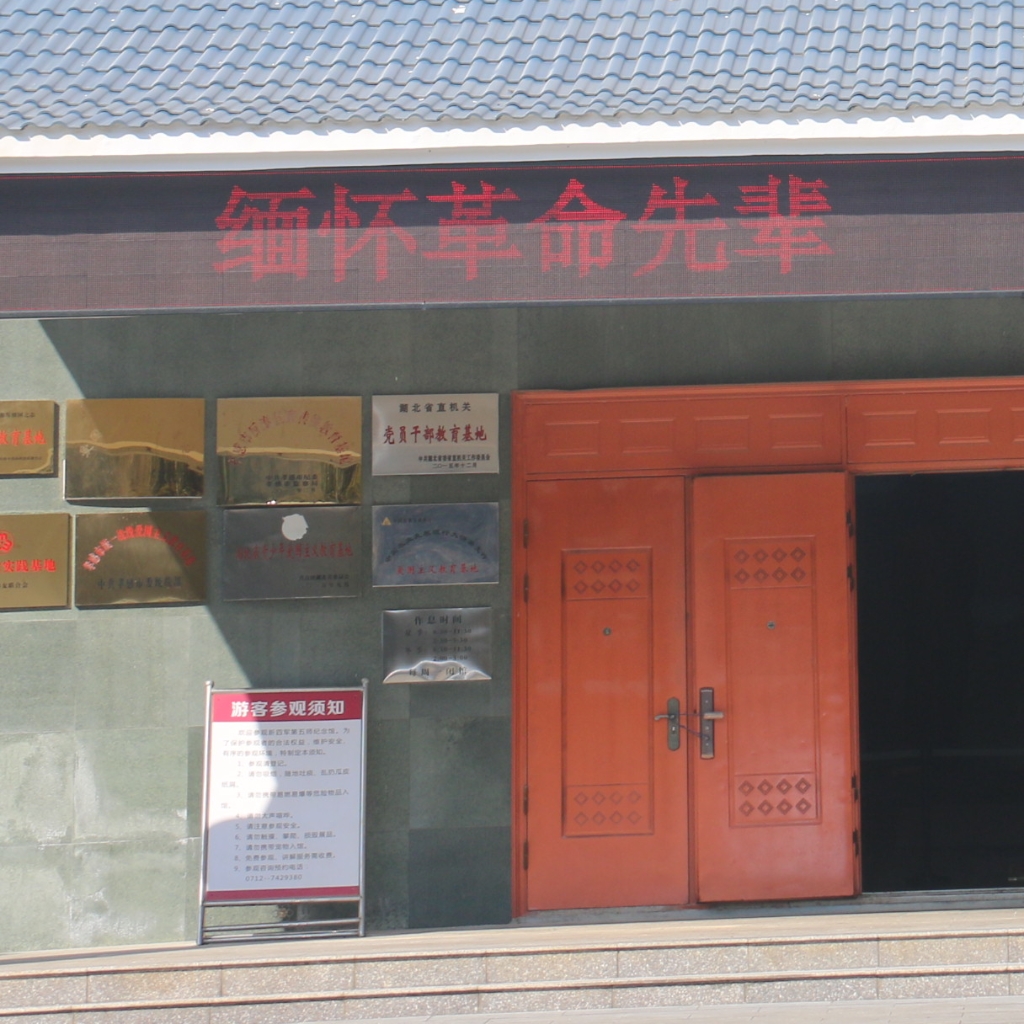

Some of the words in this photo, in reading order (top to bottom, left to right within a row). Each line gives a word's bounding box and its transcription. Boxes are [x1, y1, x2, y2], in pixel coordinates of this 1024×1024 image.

[213, 174, 834, 281] 缅怀革命先辈
[399, 401, 472, 413] 湖北省直机关
[383, 424, 488, 444] 党员干部教育基地
[231, 700, 345, 718] 游客参观须知
